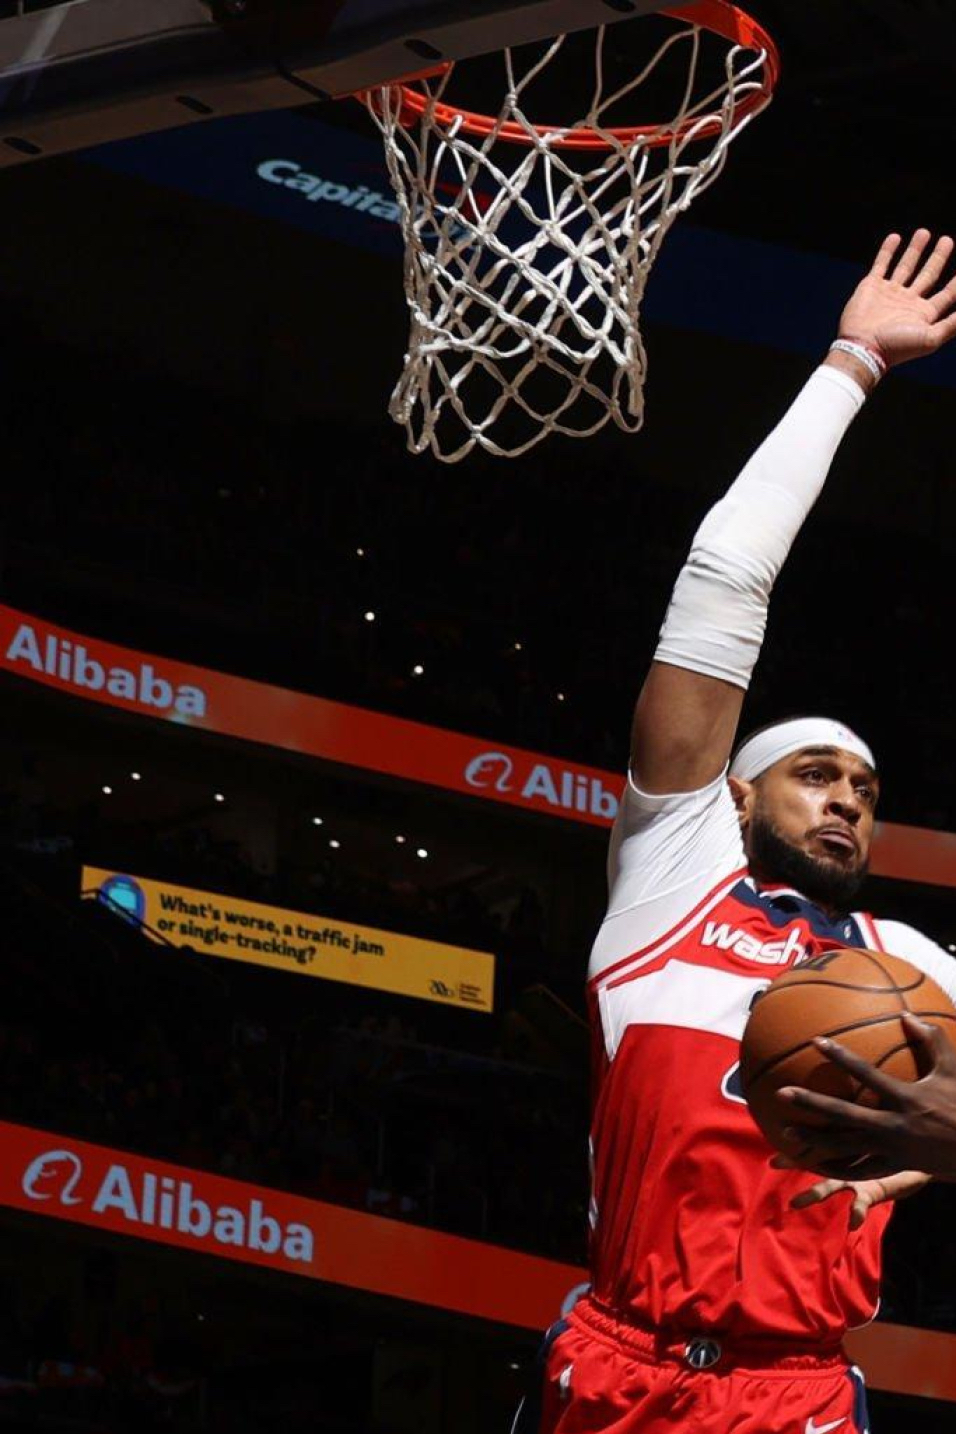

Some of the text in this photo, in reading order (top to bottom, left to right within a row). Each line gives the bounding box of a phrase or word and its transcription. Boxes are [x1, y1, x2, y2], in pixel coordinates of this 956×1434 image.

[6, 623, 207, 718] Alibaba
[520, 763, 620, 820] Alib
[157, 918, 317, 966] or single-tracking?
[160, 894, 385, 956] What's worse, a traffic jam
[91, 1164, 314, 1263] Alibaba
